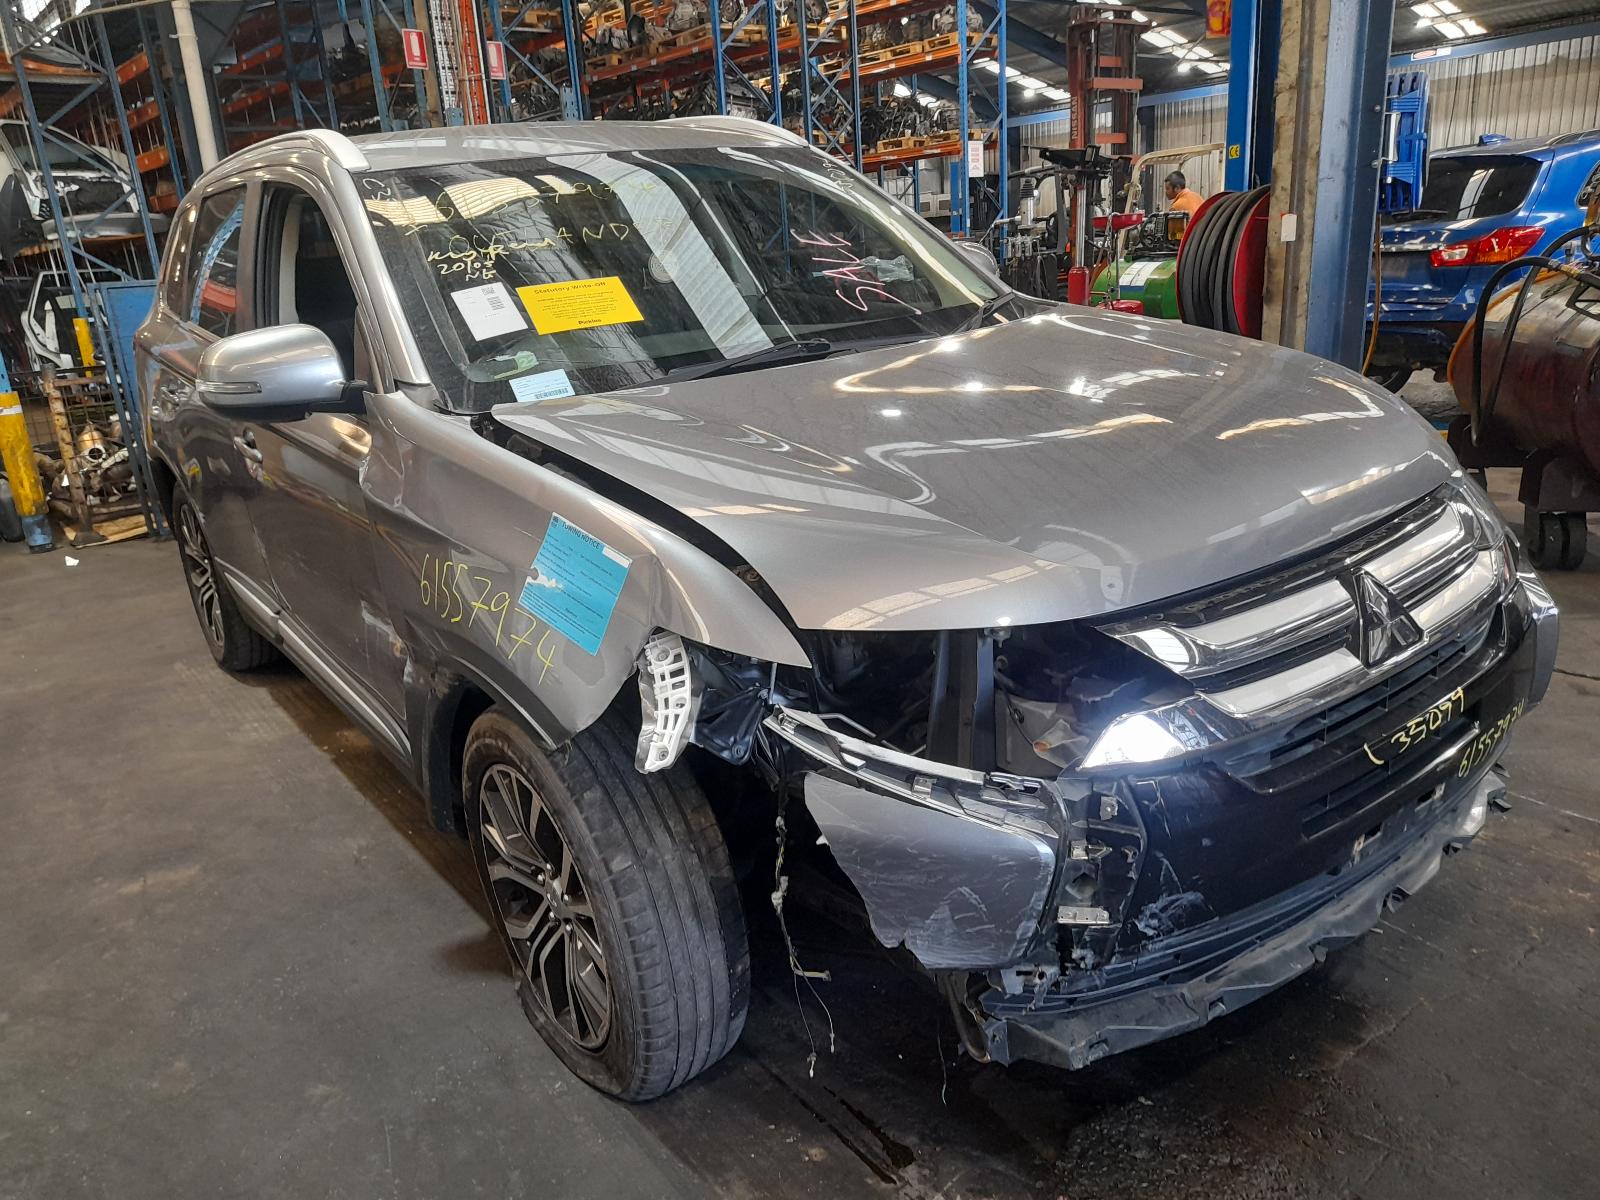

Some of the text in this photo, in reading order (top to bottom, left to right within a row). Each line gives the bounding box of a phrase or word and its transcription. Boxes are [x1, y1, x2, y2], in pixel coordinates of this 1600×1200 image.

[533, 284, 570, 296] Statutory
[581, 533, 601, 550] NOTICE
[419, 552, 557, 685] 61557974
